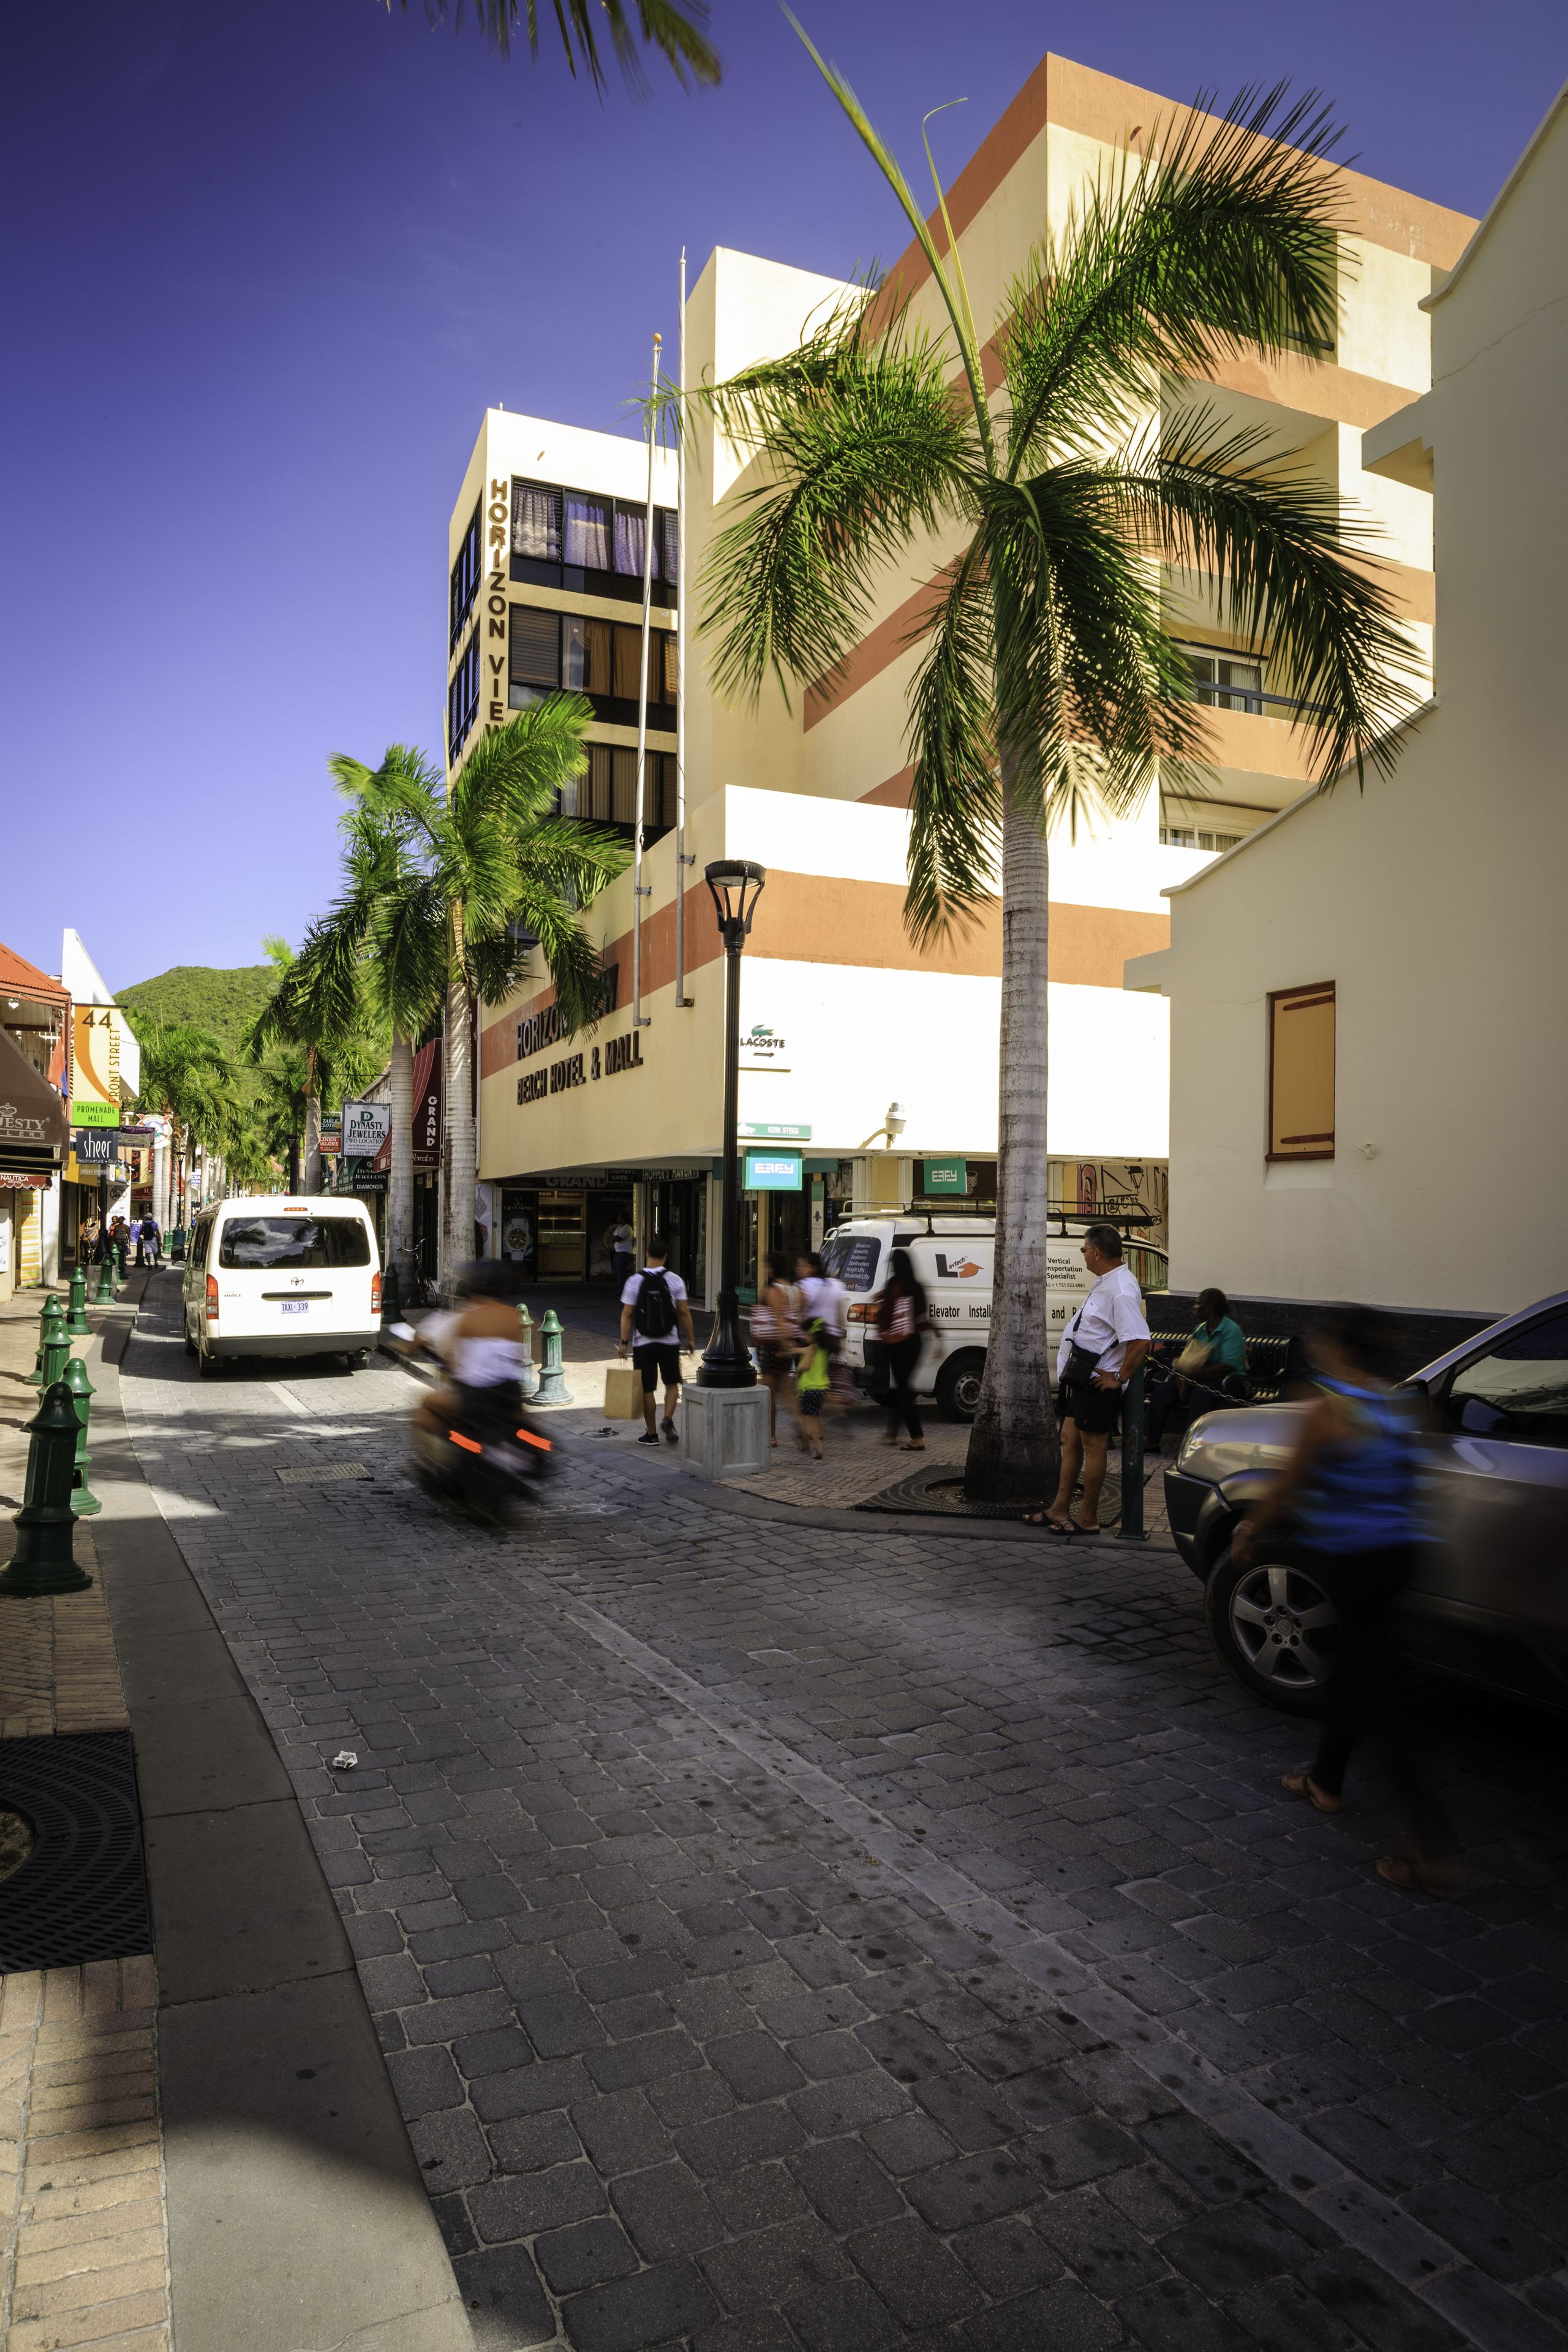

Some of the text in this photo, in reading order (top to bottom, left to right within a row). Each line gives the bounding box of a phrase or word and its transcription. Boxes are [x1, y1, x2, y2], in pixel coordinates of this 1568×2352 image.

[489, 479, 508, 638] HORIZON
[82, 1009, 112, 1028] 44
[740, 1037, 785, 1049] LACOSTE
[109, 1029, 119, 1102] FRONT STREET
[517, 1030, 643, 1105] BEACH HOTEL & MALL
[0, 1117, 45, 1130] JESTY
[350, 1120, 383, 1129] DYNASTY
[426, 1096, 437, 1147] GRAND
[347, 1129, 386, 1139] JEWELERS
[84, 1132, 112, 1158] sheer
[282, 1303, 293, 1312] TAXI
[929, 1304, 960, 1317] Elevator
[969, 1305, 991, 1318] Install
[1052, 1306, 1065, 1319] and
